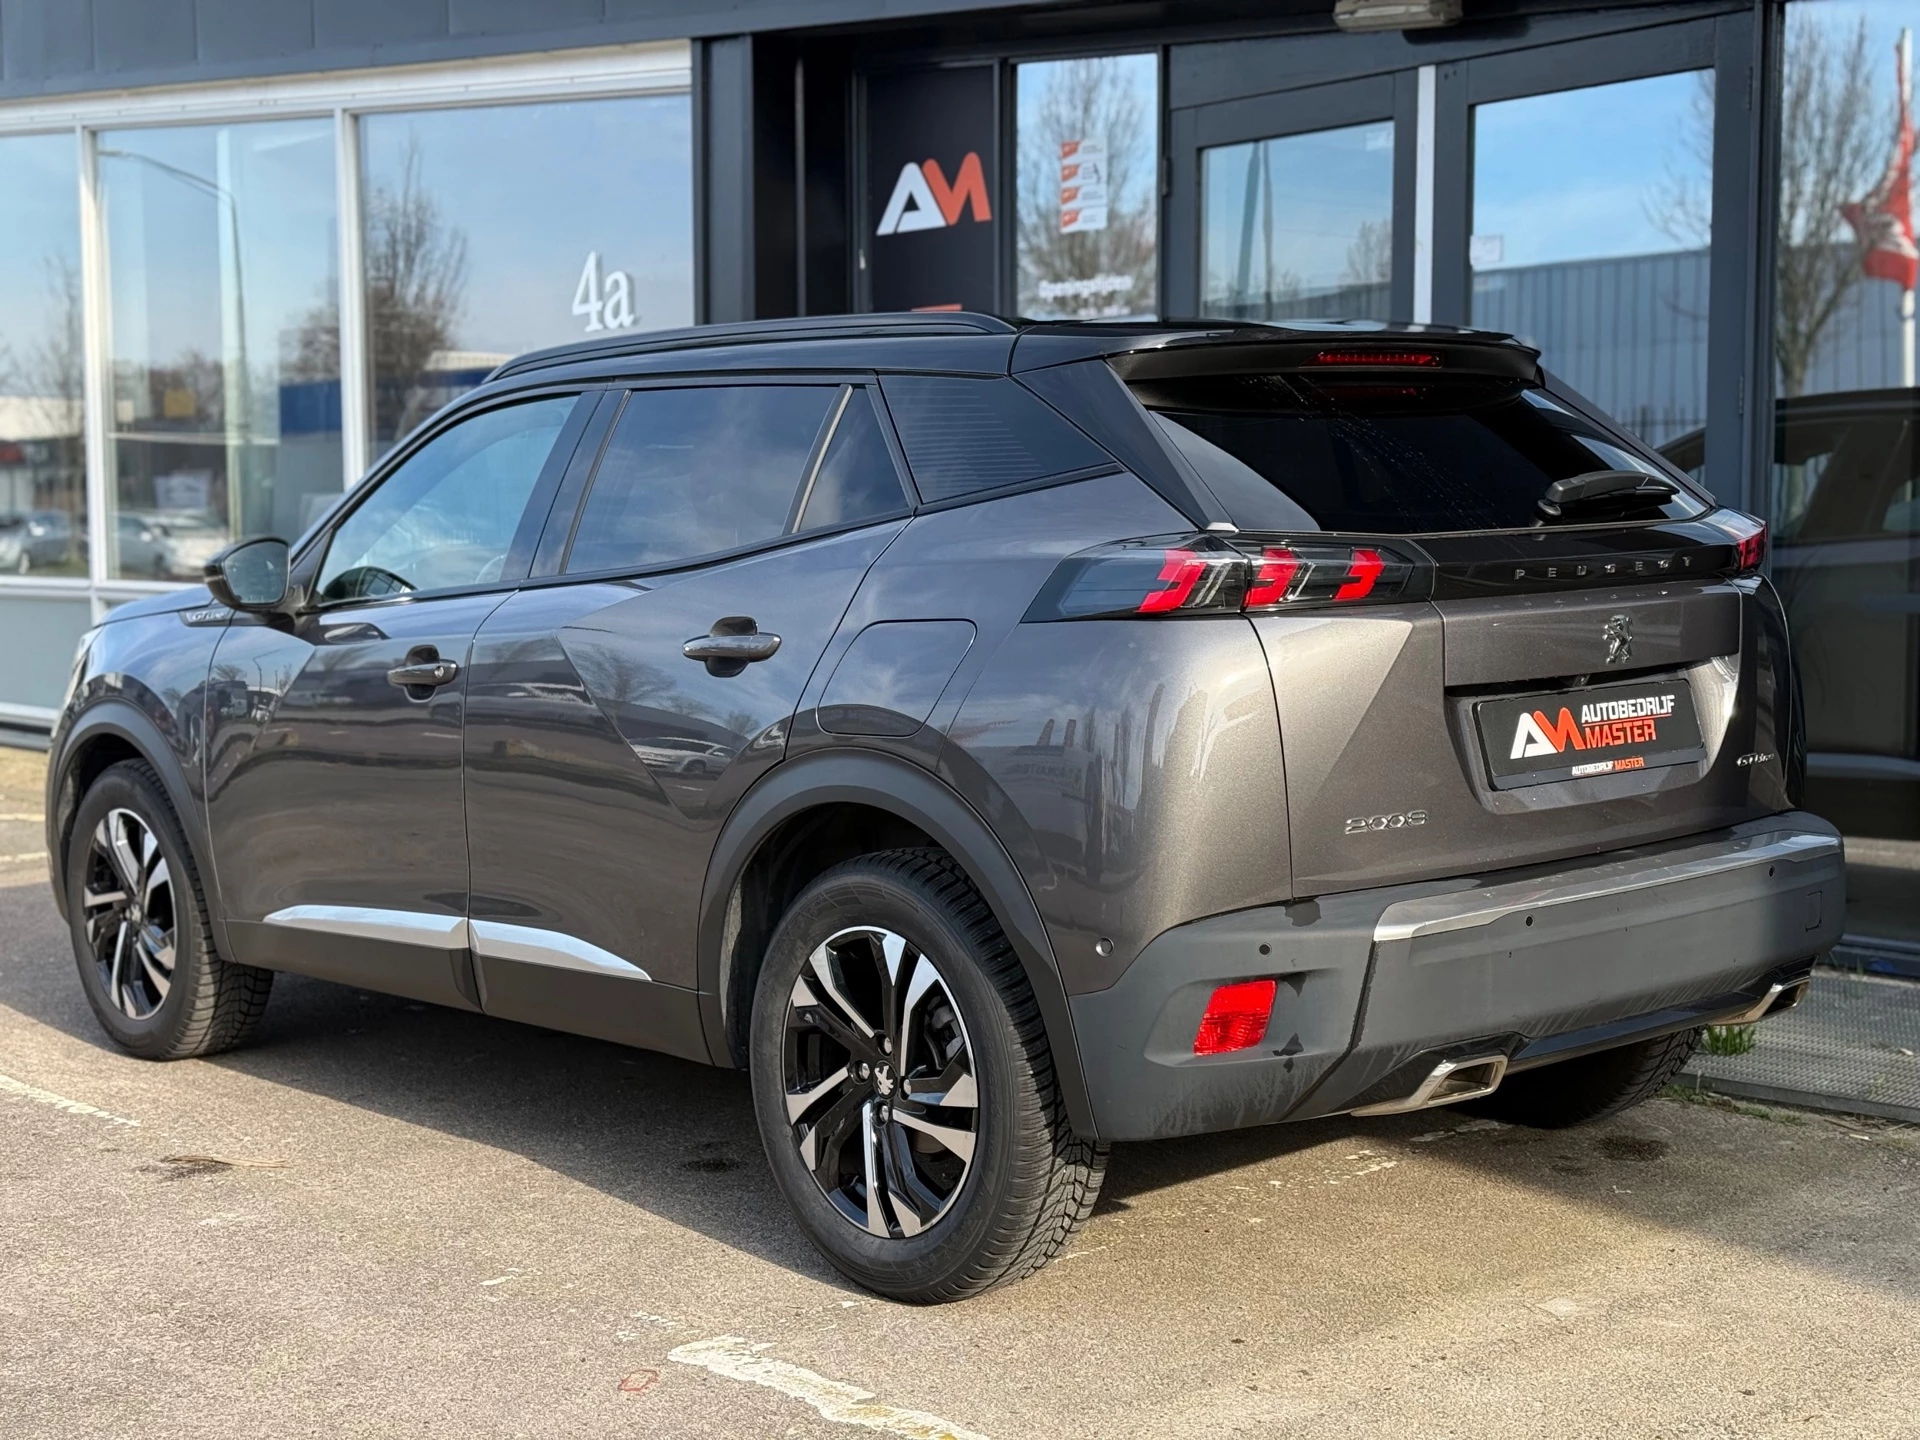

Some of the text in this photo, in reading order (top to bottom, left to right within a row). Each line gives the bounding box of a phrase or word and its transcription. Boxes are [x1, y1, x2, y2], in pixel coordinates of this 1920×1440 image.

[876, 152, 992, 236] AM
[572, 250, 634, 333] 4a
[1514, 556, 1693, 580] PEUGEOT
[1510, 695, 1675, 759] AM AUTOBEDRIJF
[1585, 720, 1657, 749] MASTER
[1615, 757, 1645, 771] MASTER
[1345, 810, 1428, 835] 2008
